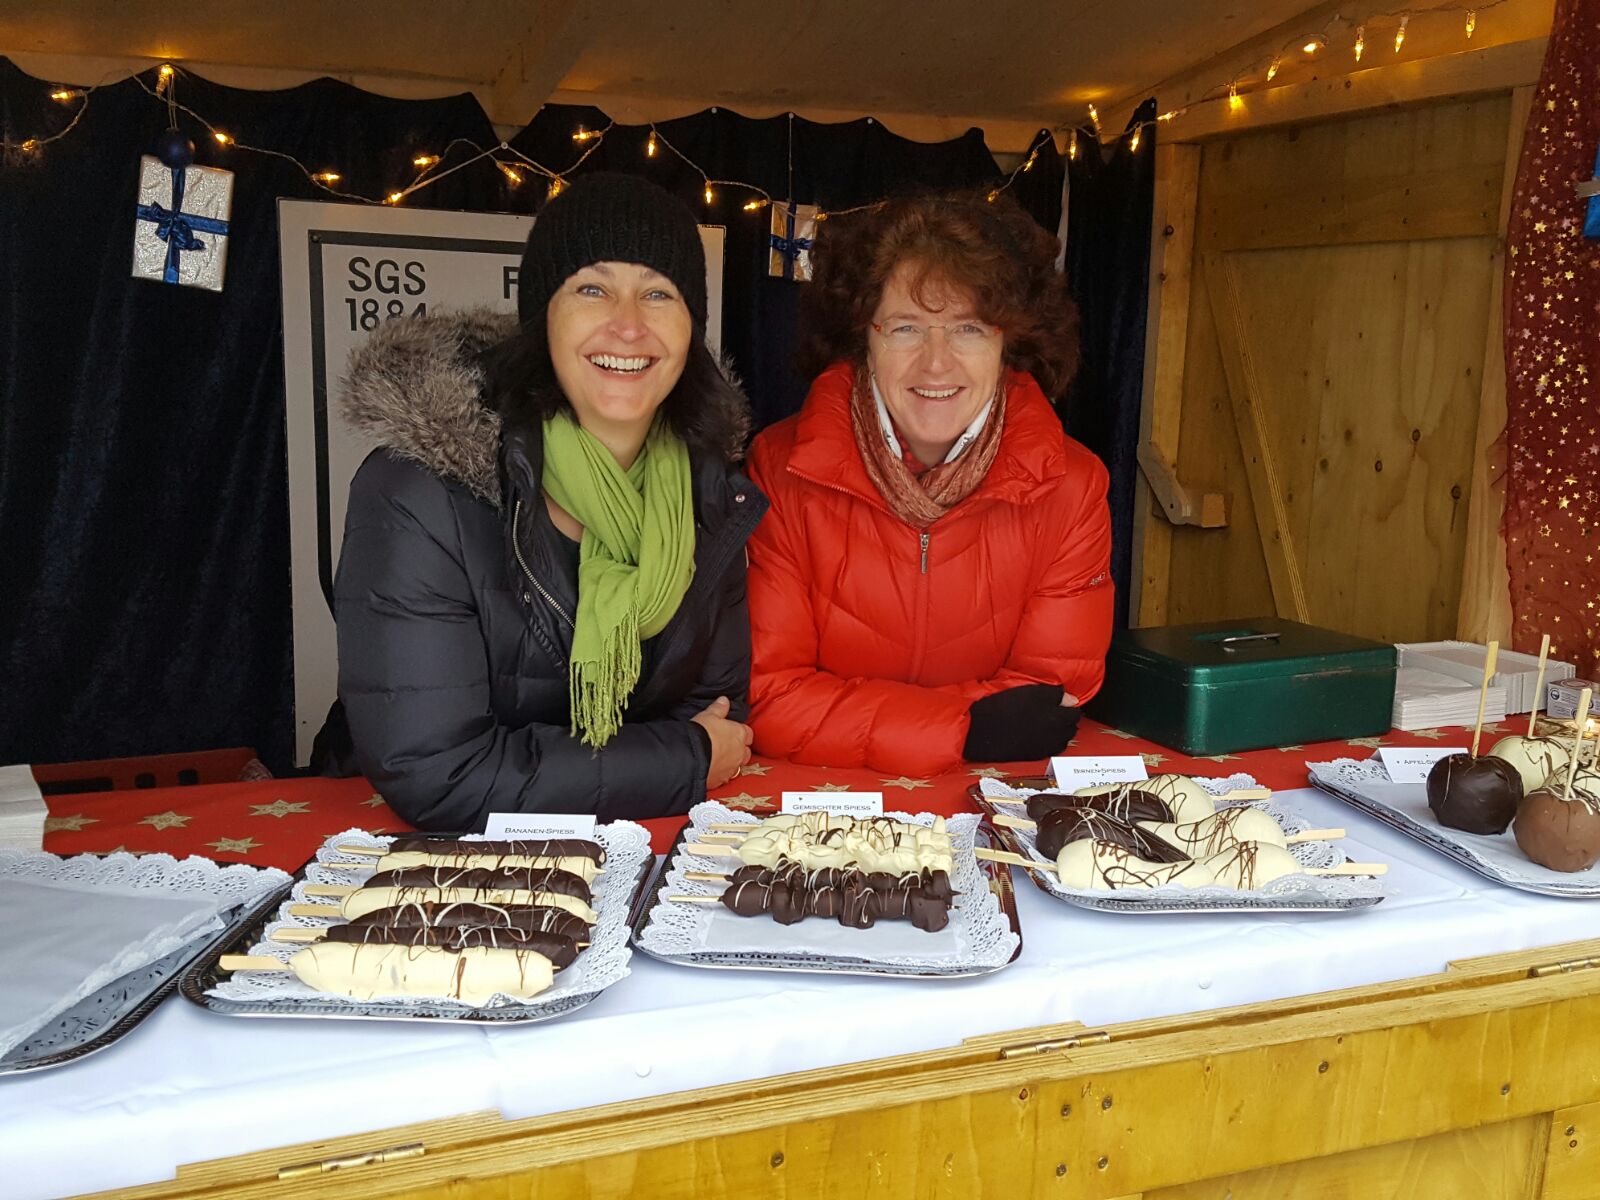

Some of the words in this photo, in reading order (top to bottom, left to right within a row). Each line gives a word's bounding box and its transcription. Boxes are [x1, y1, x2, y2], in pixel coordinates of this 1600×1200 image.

[347, 256, 426, 296] SGS
[792, 803, 842, 811] GEMISCHTER
[504, 827, 576, 835] BANANEN-SPIESS
